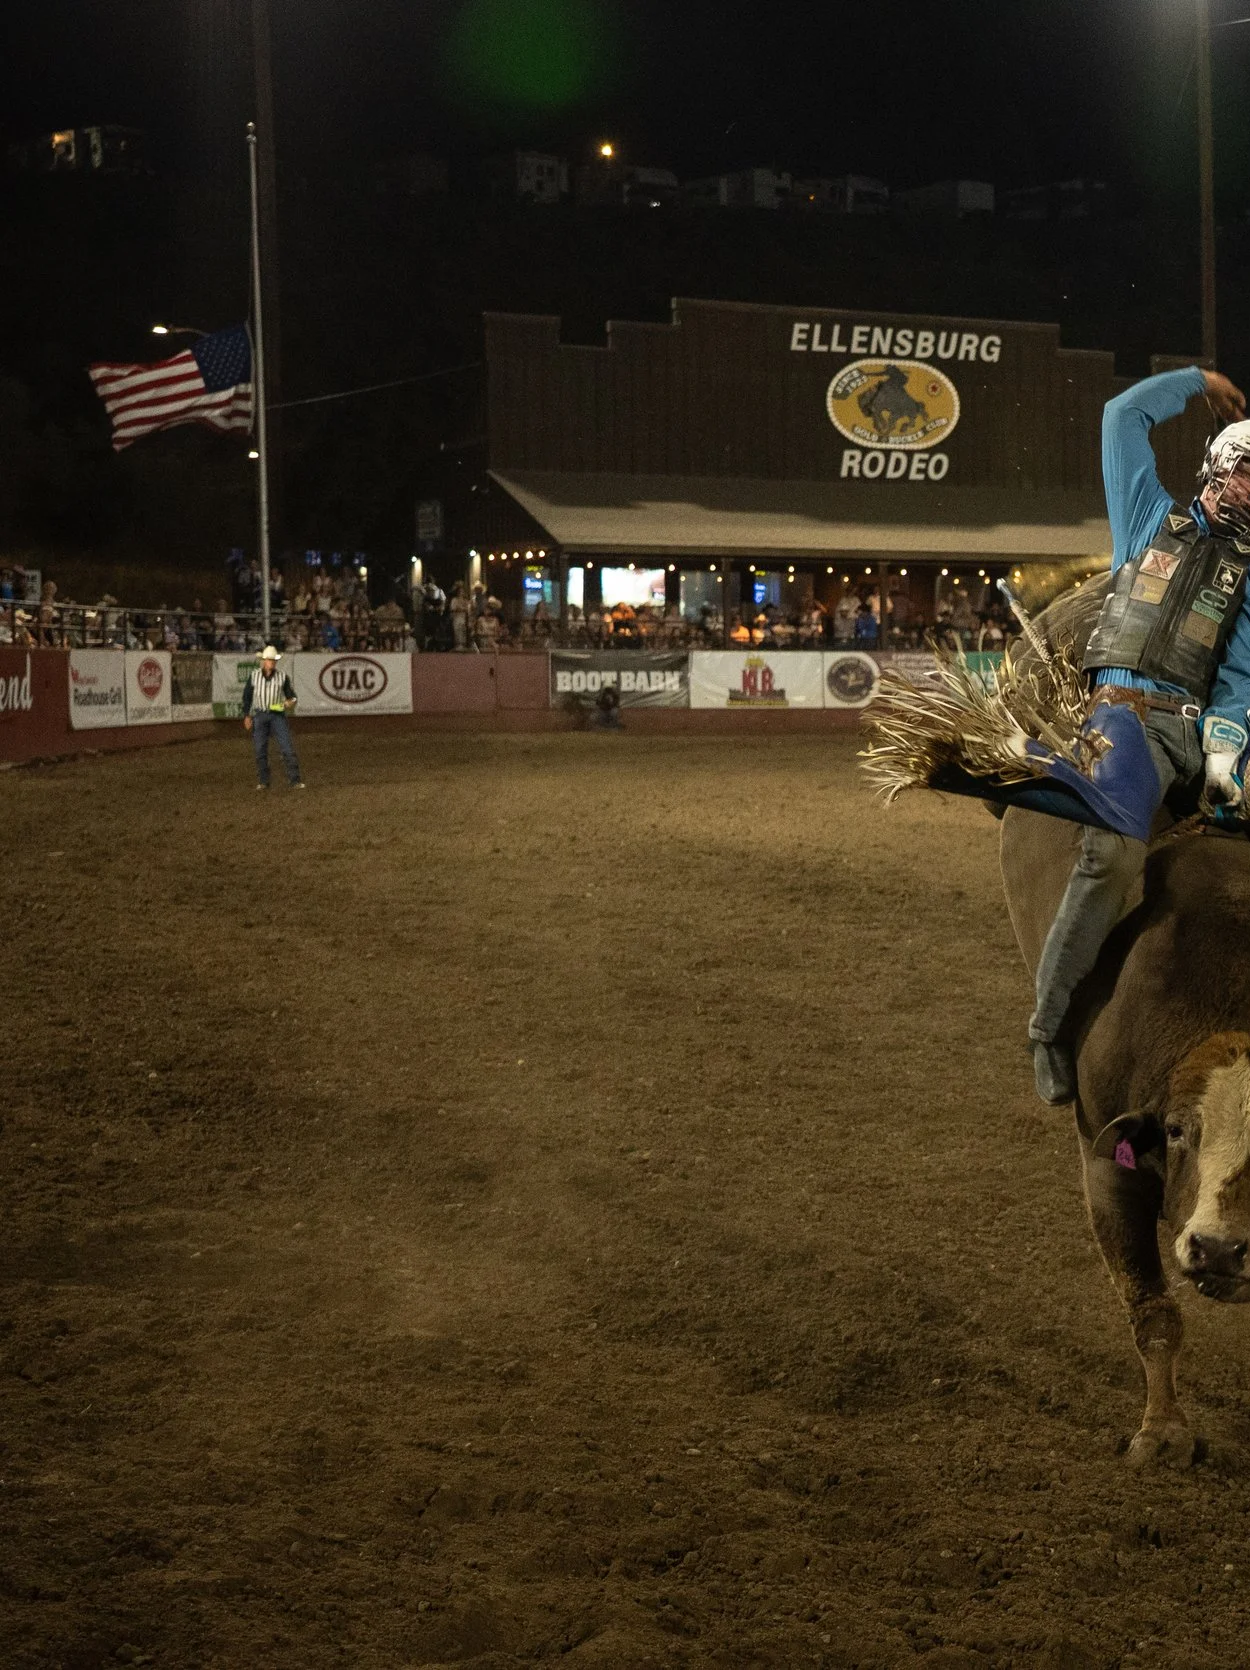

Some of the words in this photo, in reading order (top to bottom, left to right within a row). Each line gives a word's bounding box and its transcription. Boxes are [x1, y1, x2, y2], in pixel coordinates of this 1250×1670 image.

[790, 321, 1002, 363] ELLENSBURG
[839, 448, 950, 482] RODEO
[331, 669, 375, 690] UAC
[556, 670, 618, 693] BOOT
[620, 670, 681, 692] BARN
